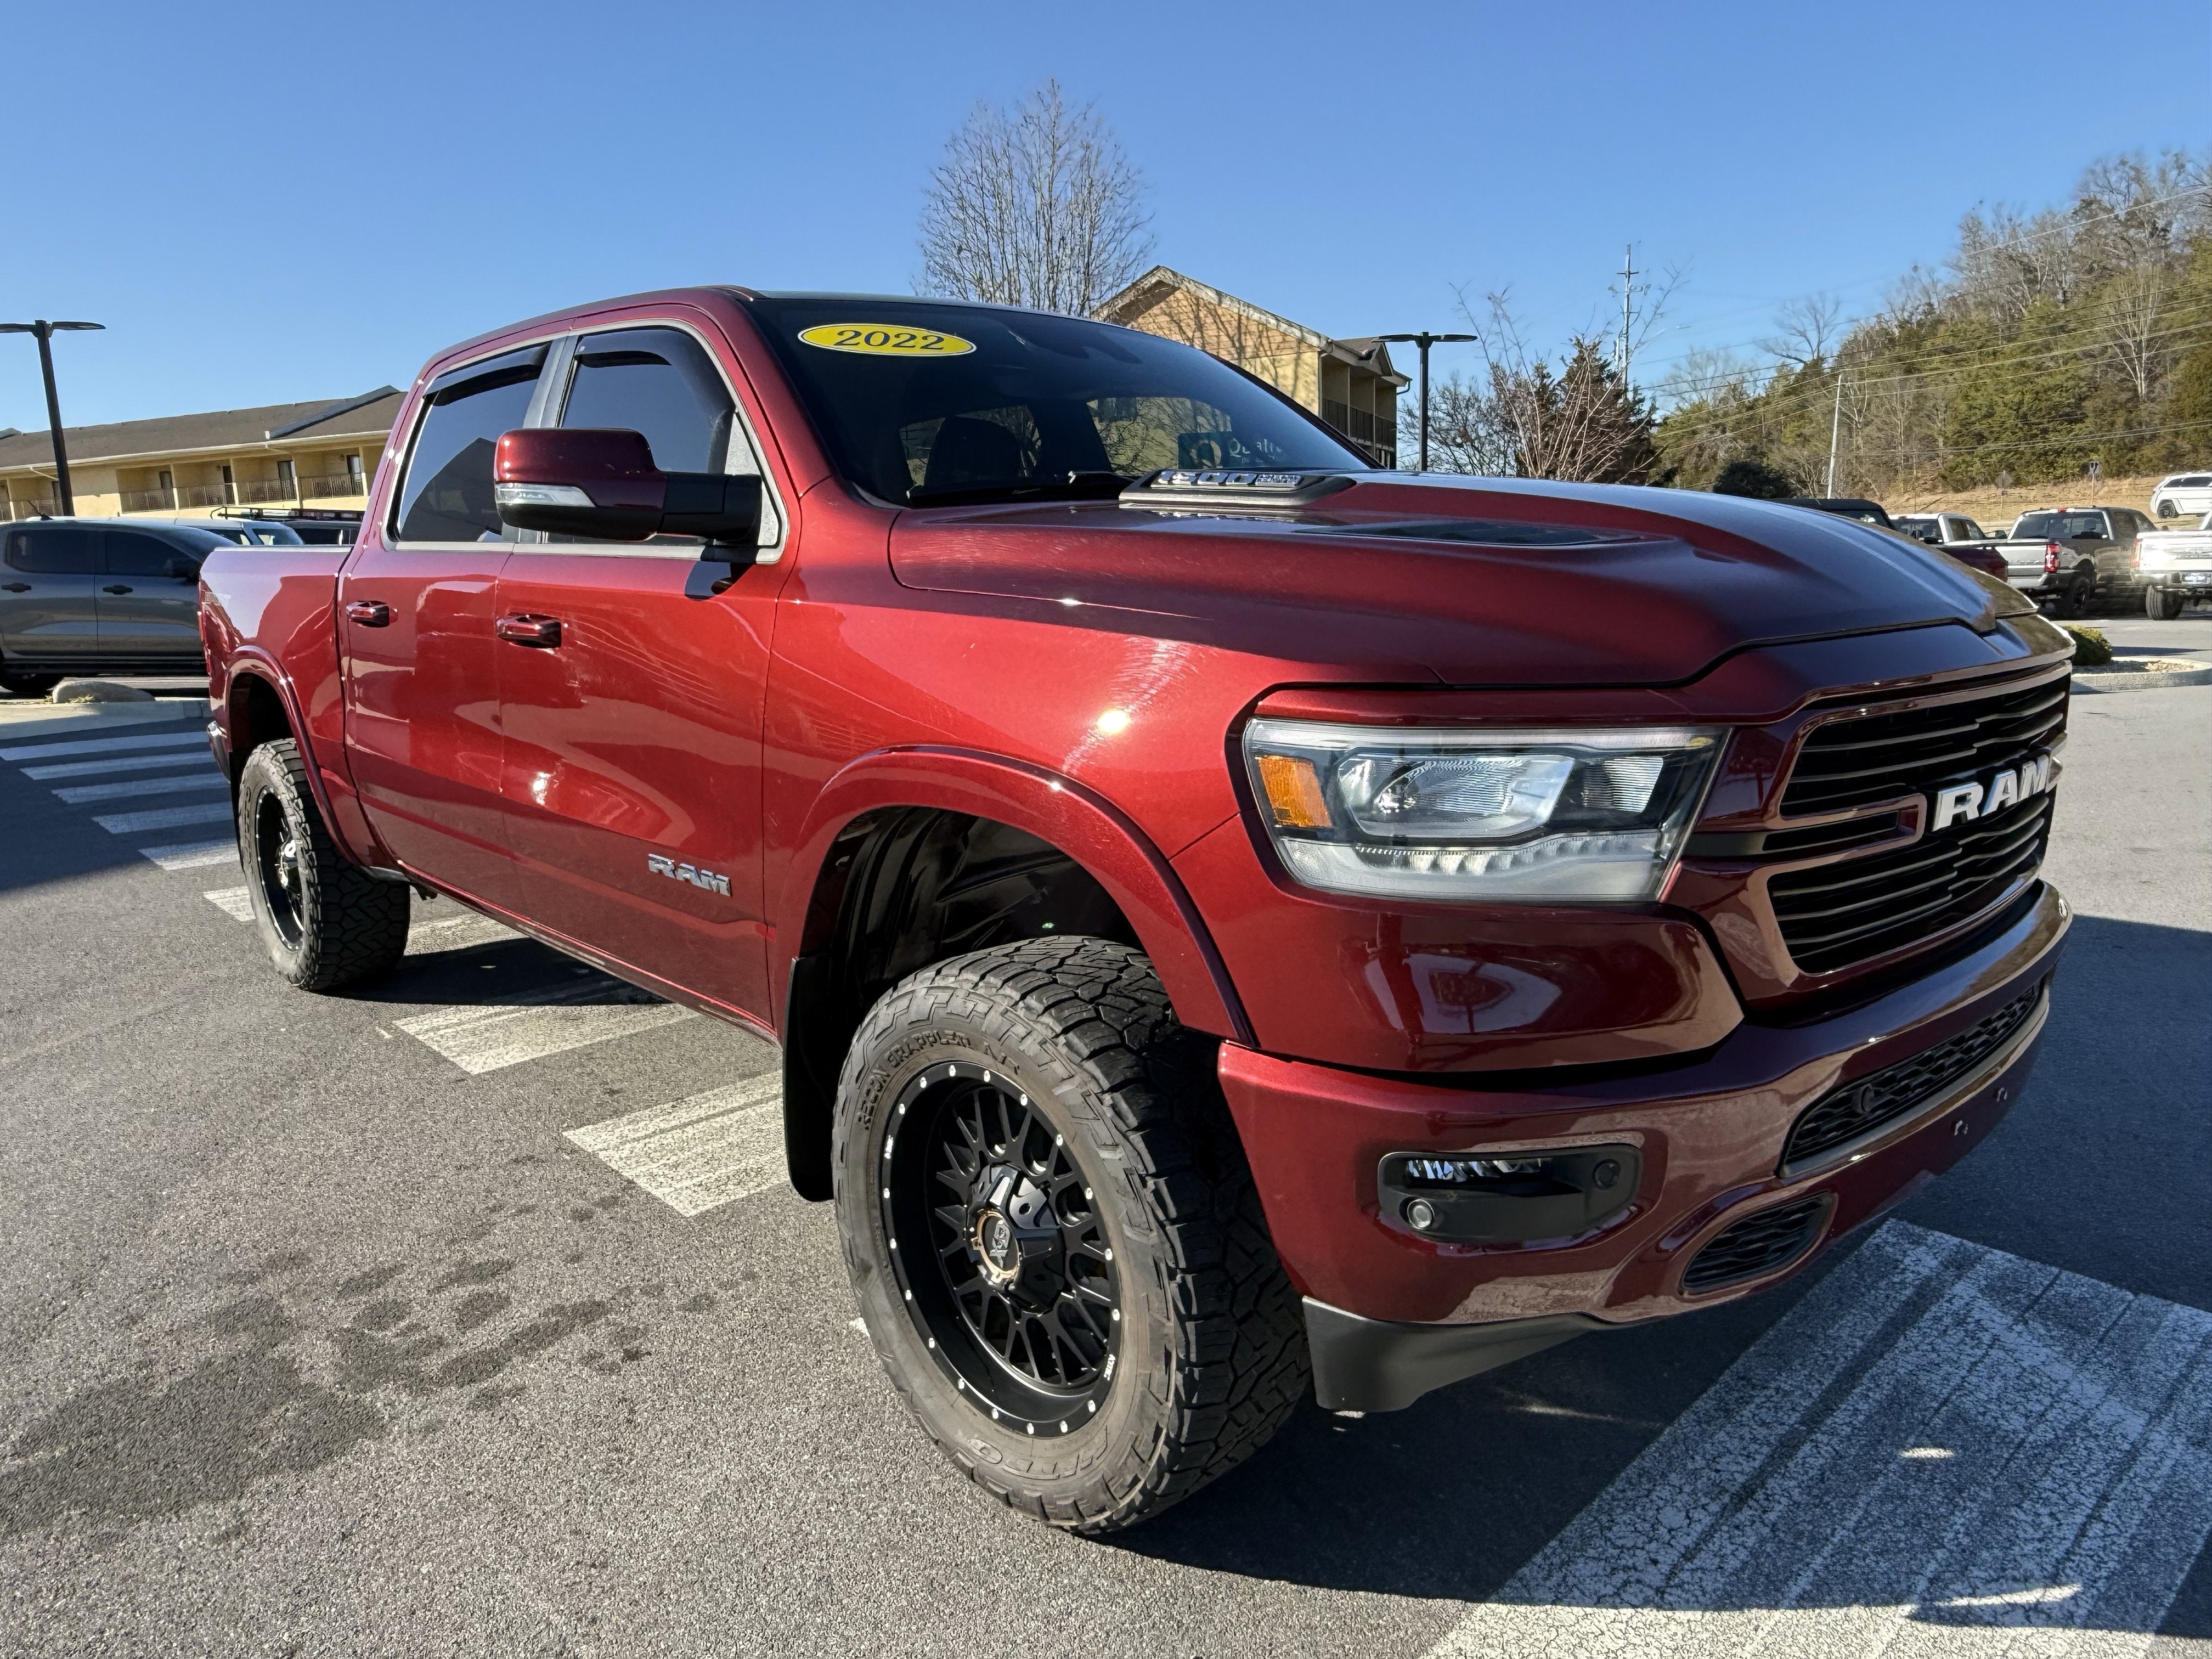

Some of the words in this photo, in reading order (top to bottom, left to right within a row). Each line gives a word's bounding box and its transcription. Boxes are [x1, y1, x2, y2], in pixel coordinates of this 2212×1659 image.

[833, 329, 945, 351] 2022
[1932, 754, 2051, 832] RAM
[648, 853, 732, 897] RAM
